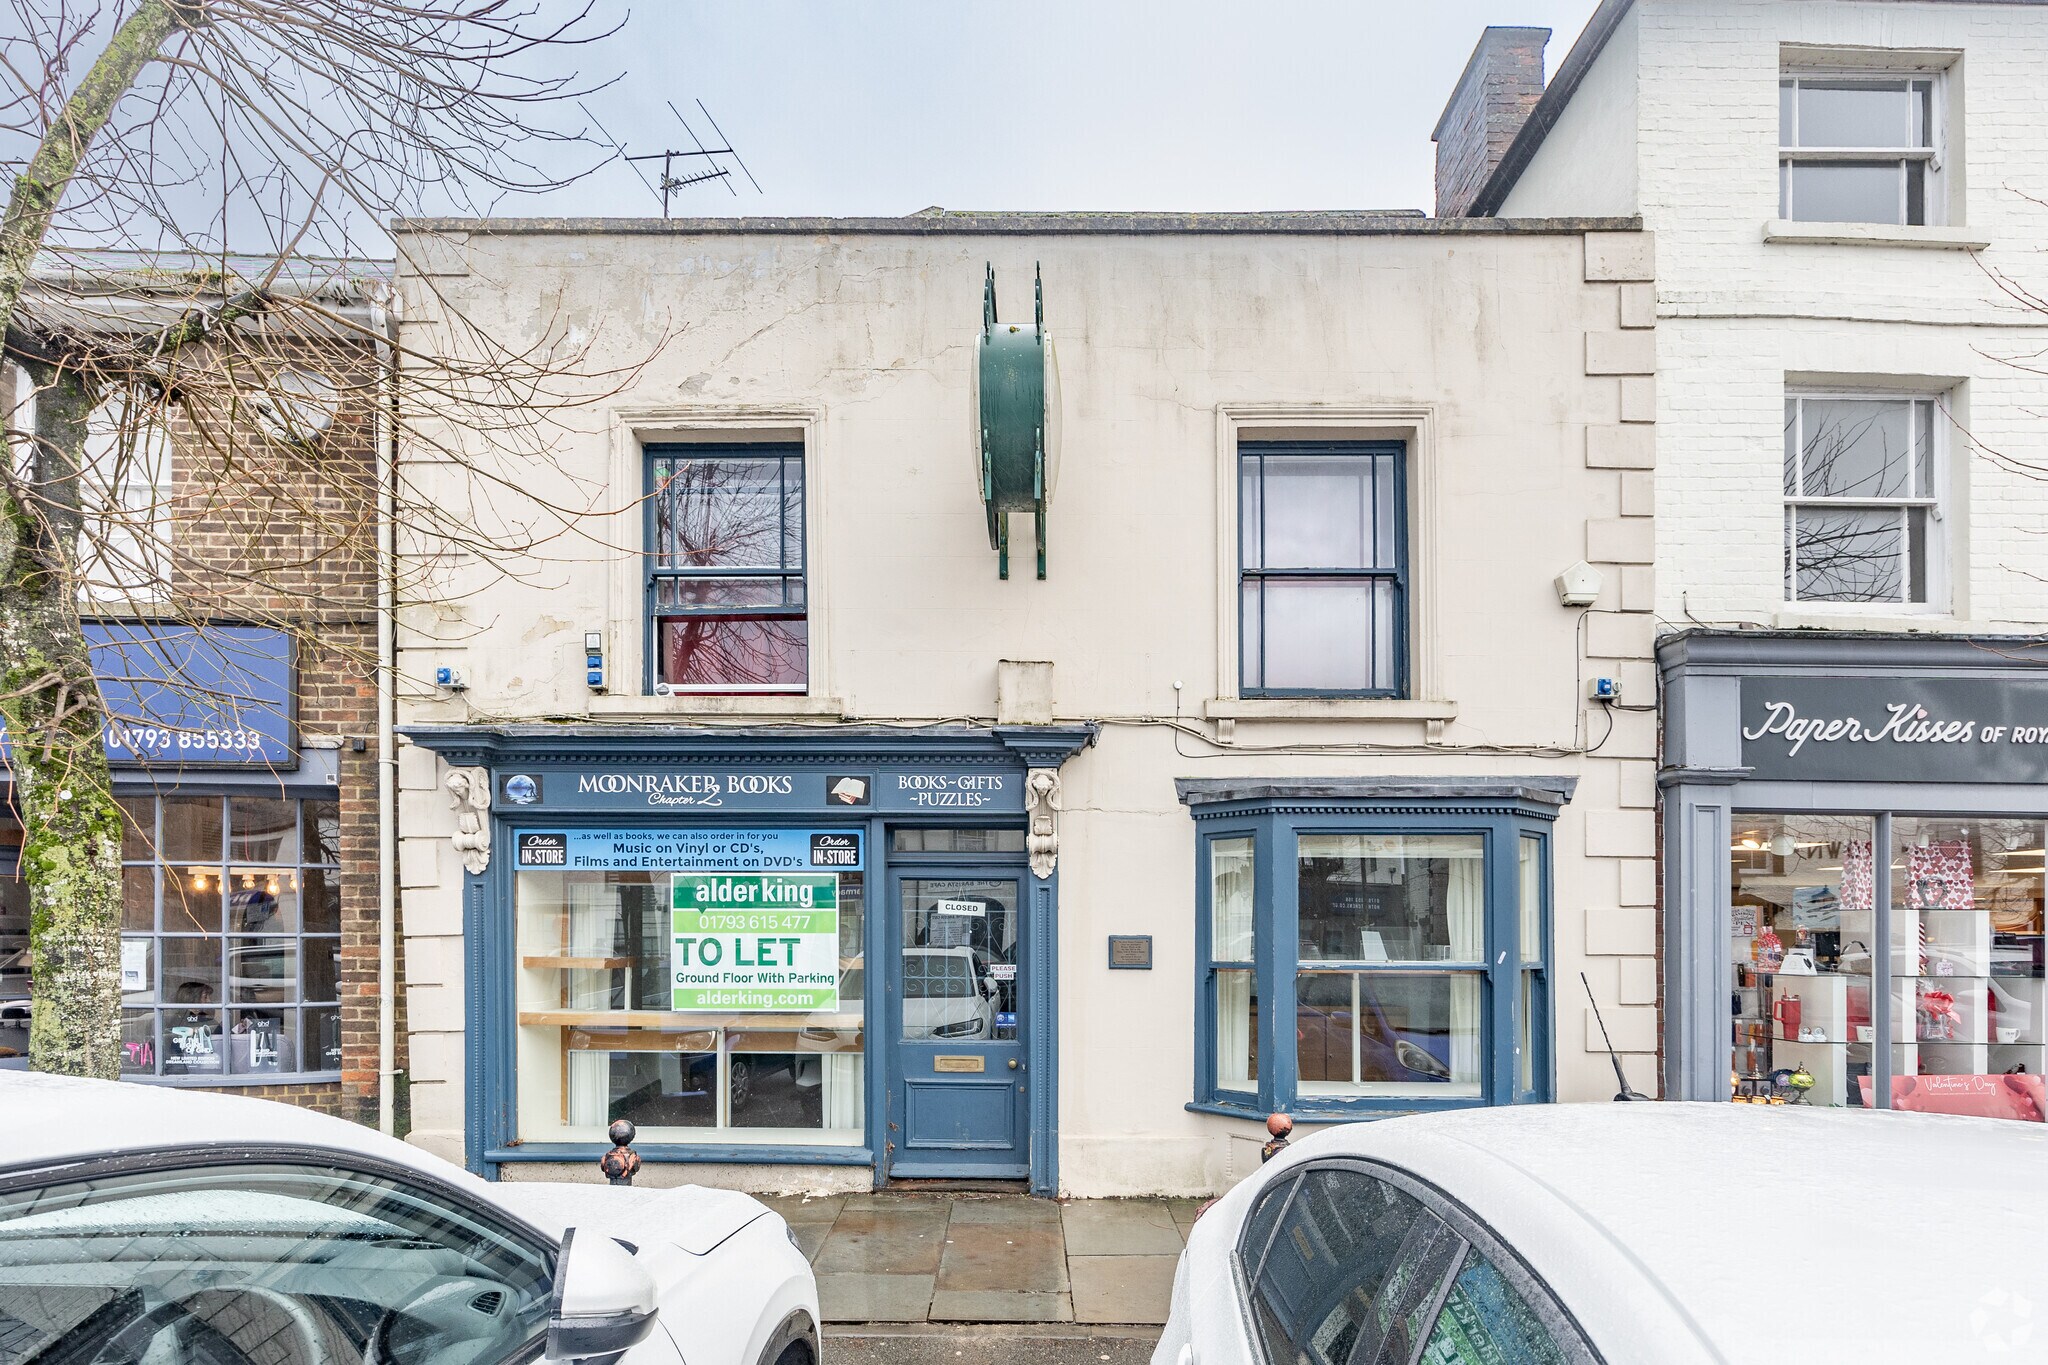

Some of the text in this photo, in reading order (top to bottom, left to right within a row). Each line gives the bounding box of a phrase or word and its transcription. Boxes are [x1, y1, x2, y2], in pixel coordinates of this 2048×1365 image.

[1743, 701, 1862, 757] Paper
[1864, 703, 1975, 742] Kisses
[1980, 726, 2007, 743] OF
[109, 729, 260, 749] 01793 855333
[578, 774, 792, 794] MOONRAKER BOOKS
[648, 784, 722, 807] Chapter 2
[527, 836, 558, 847] Order
[593, 832, 611, 840] well
[625, 832, 654, 841] books,
[691, 832, 708, 840] also
[710, 832, 734, 840] order
[737, 832, 745, 840] in
[747, 832, 760, 840] for
[820, 836, 850, 847] Order
[613, 842, 764, 856] Music on Vinyl or CD's,
[522, 850, 564, 864] IN-STORE
[574, 856, 803, 867] Films and Entertainment on DVD's
[813, 850, 857, 865] IN-STORE
[696, 878, 813, 908] alder king
[945, 904, 979, 912] CLOSED
[698, 915, 811, 929] 01793 615 477
[675, 937, 801, 966] TO LET
[676, 972, 834, 985] Ground Floor With Parking
[696, 990, 813, 1008] alderking.com
[1924, 1076, 1996, 1096] Valentine's Day
